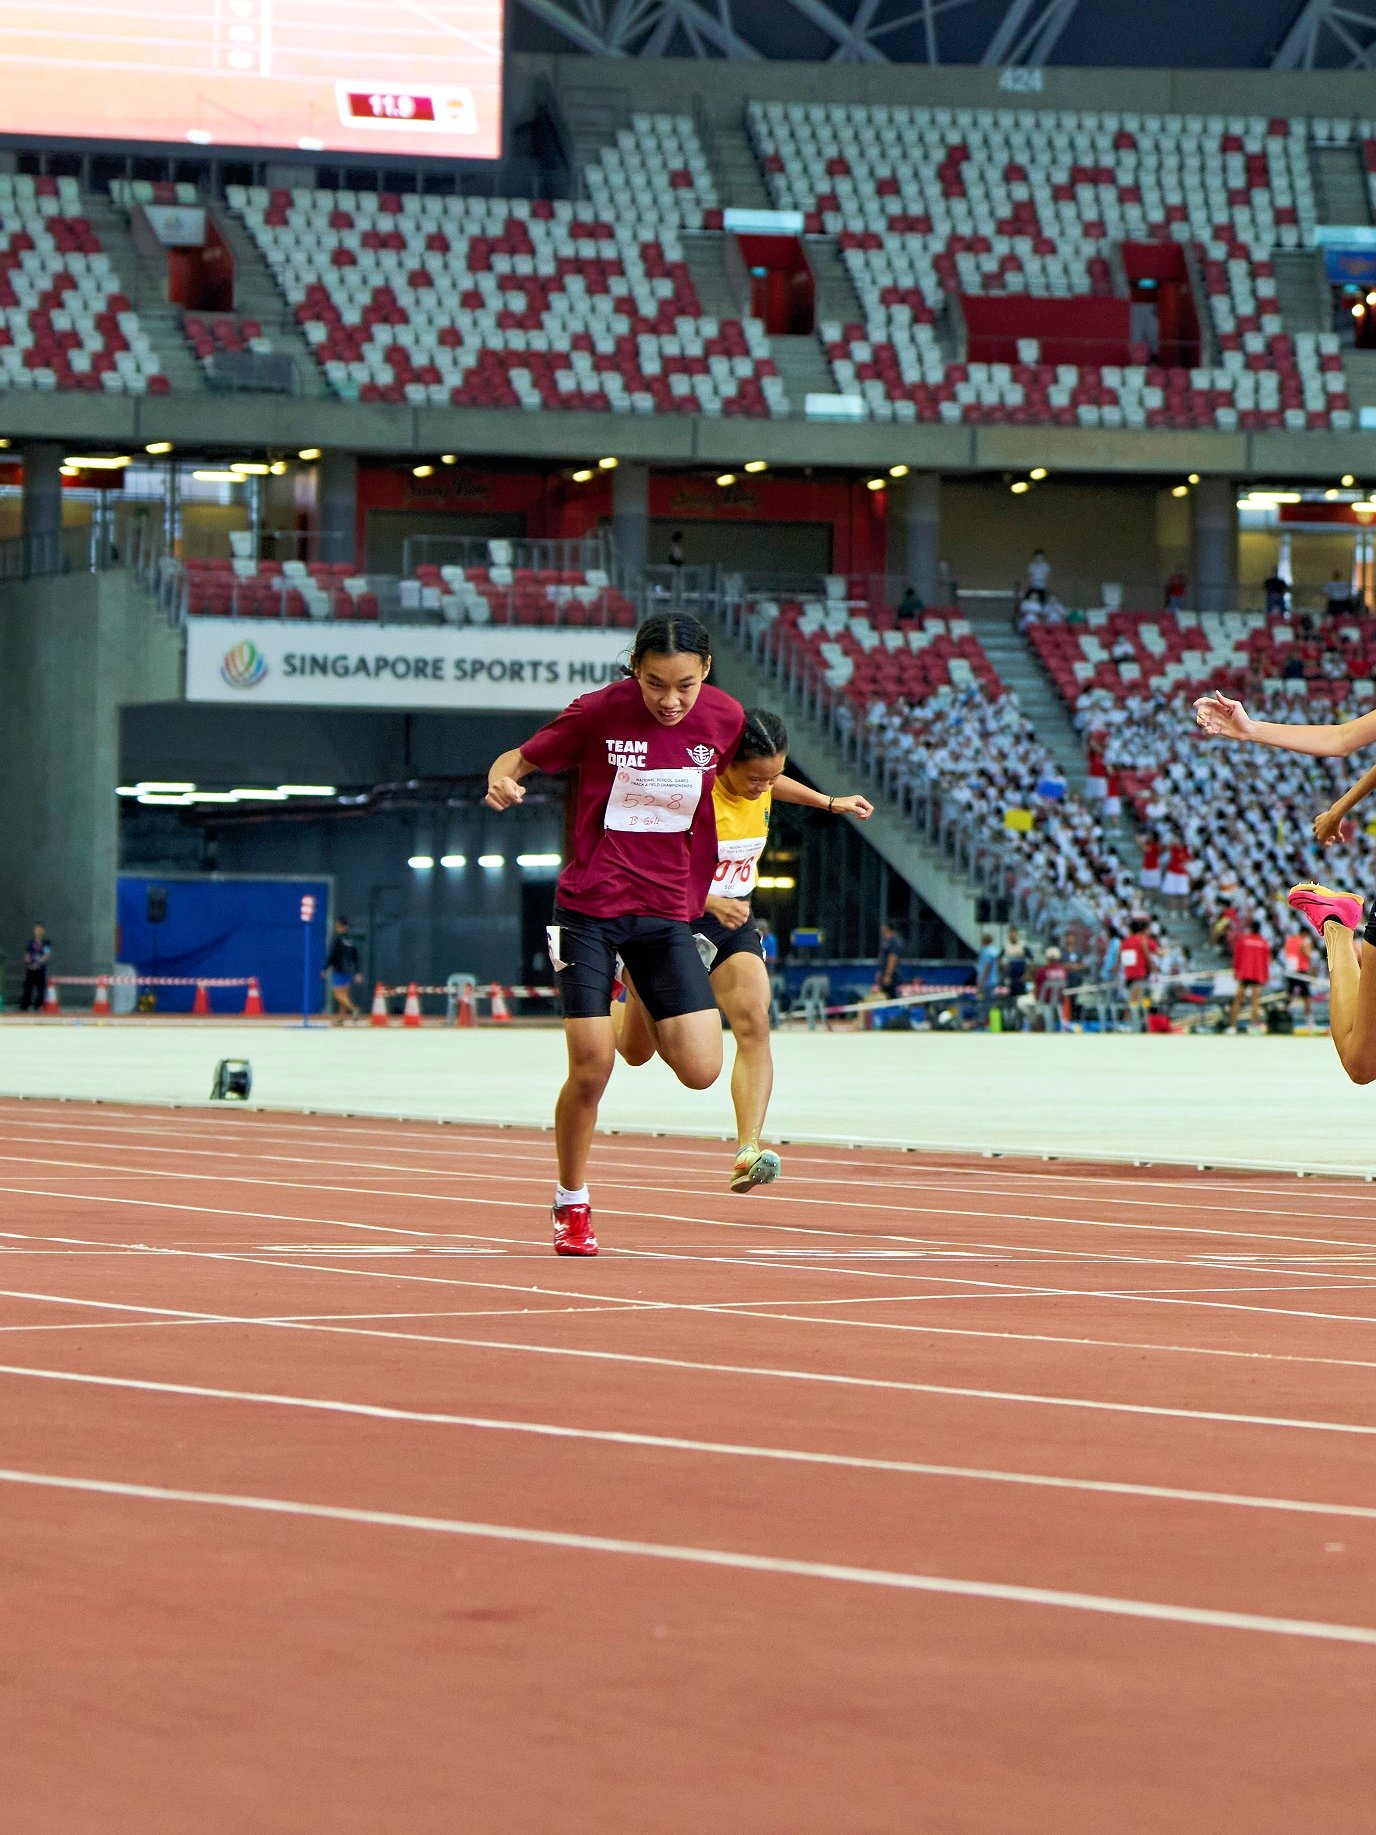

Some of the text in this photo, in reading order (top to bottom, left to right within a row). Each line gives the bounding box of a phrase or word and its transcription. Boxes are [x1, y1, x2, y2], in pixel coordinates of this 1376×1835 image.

[999, 69, 1043, 92] 424
[283, 653, 445, 681] SINGAPORE
[453, 657, 559, 684] SPORTS
[605, 739, 648, 754] TEAM
[622, 793, 684, 810] 528
